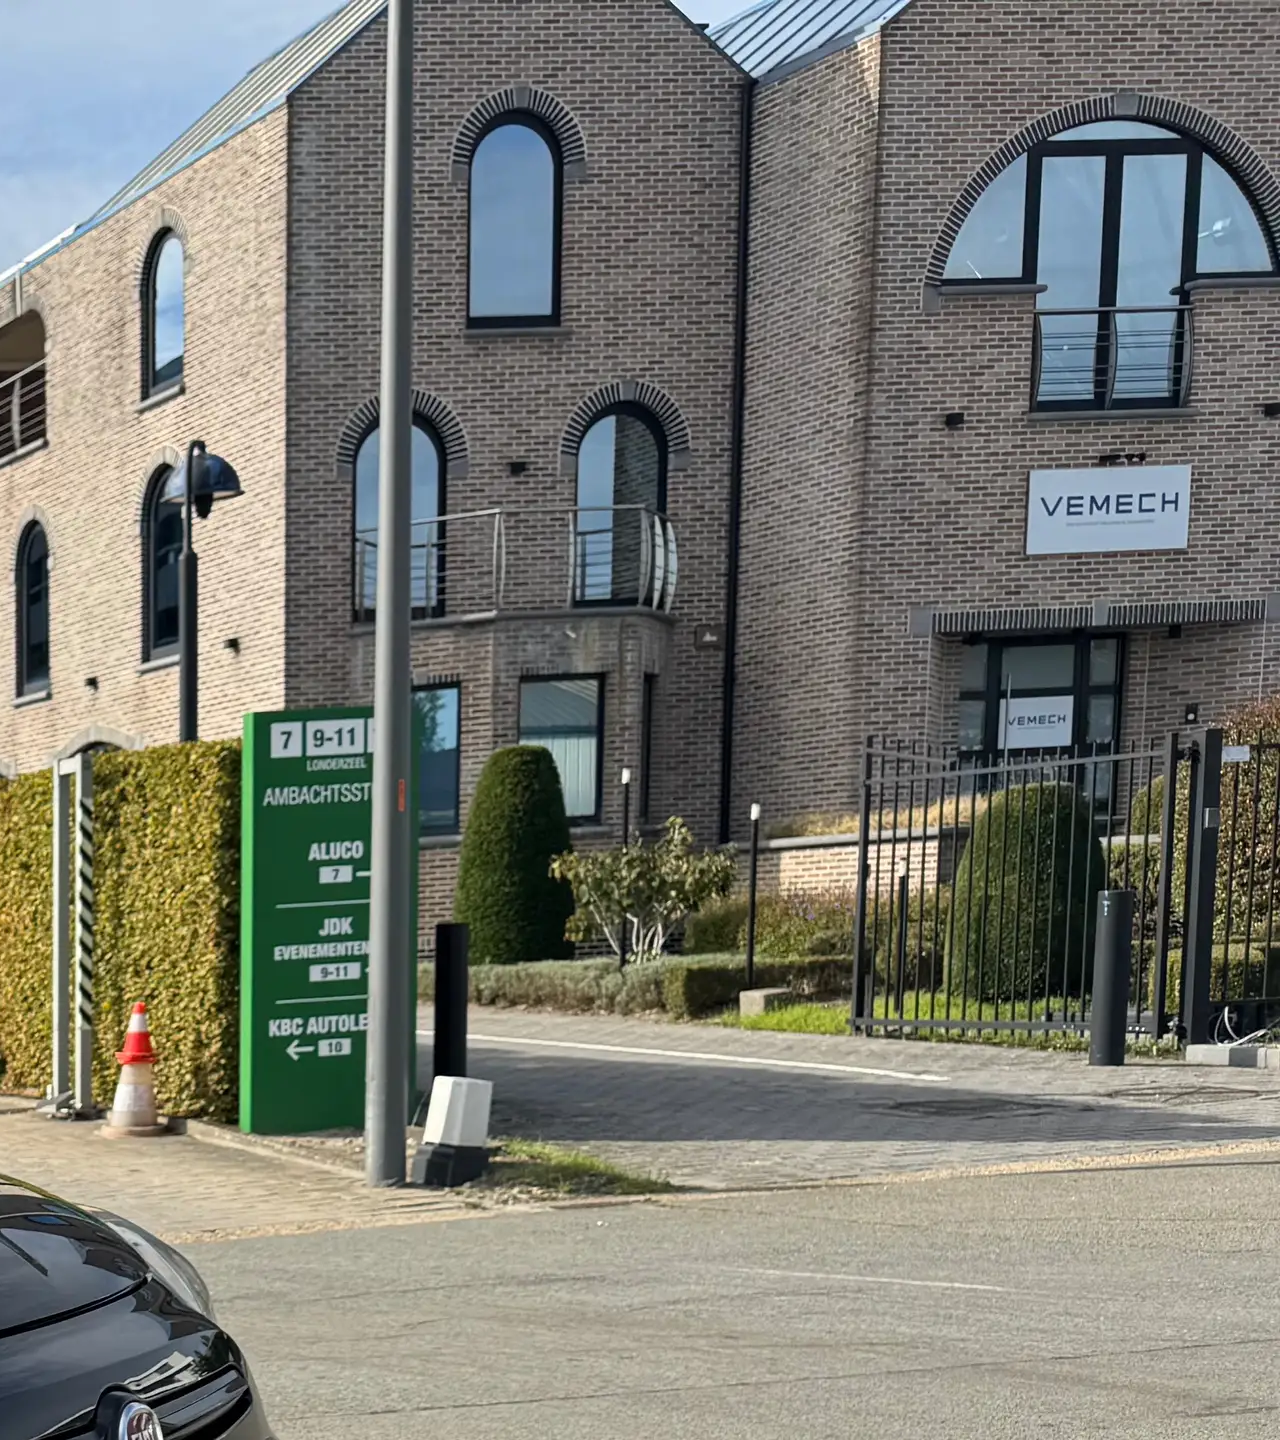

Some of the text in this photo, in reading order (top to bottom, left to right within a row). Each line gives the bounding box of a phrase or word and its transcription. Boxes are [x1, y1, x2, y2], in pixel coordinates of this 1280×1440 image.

[1039, 491, 1180, 517] VEMECH
[1007, 713, 1067, 727] VEMECH
[280, 730, 293, 751] 7
[312, 726, 356, 749] 9-11
[307, 839, 364, 862] ALUCO
[331, 868, 340, 881] 7
[318, 916, 354, 937] JDK
[319, 965, 349, 979] 9-11
[268, 1017, 304, 1038] KBC
[327, 1041, 343, 1054] 10
